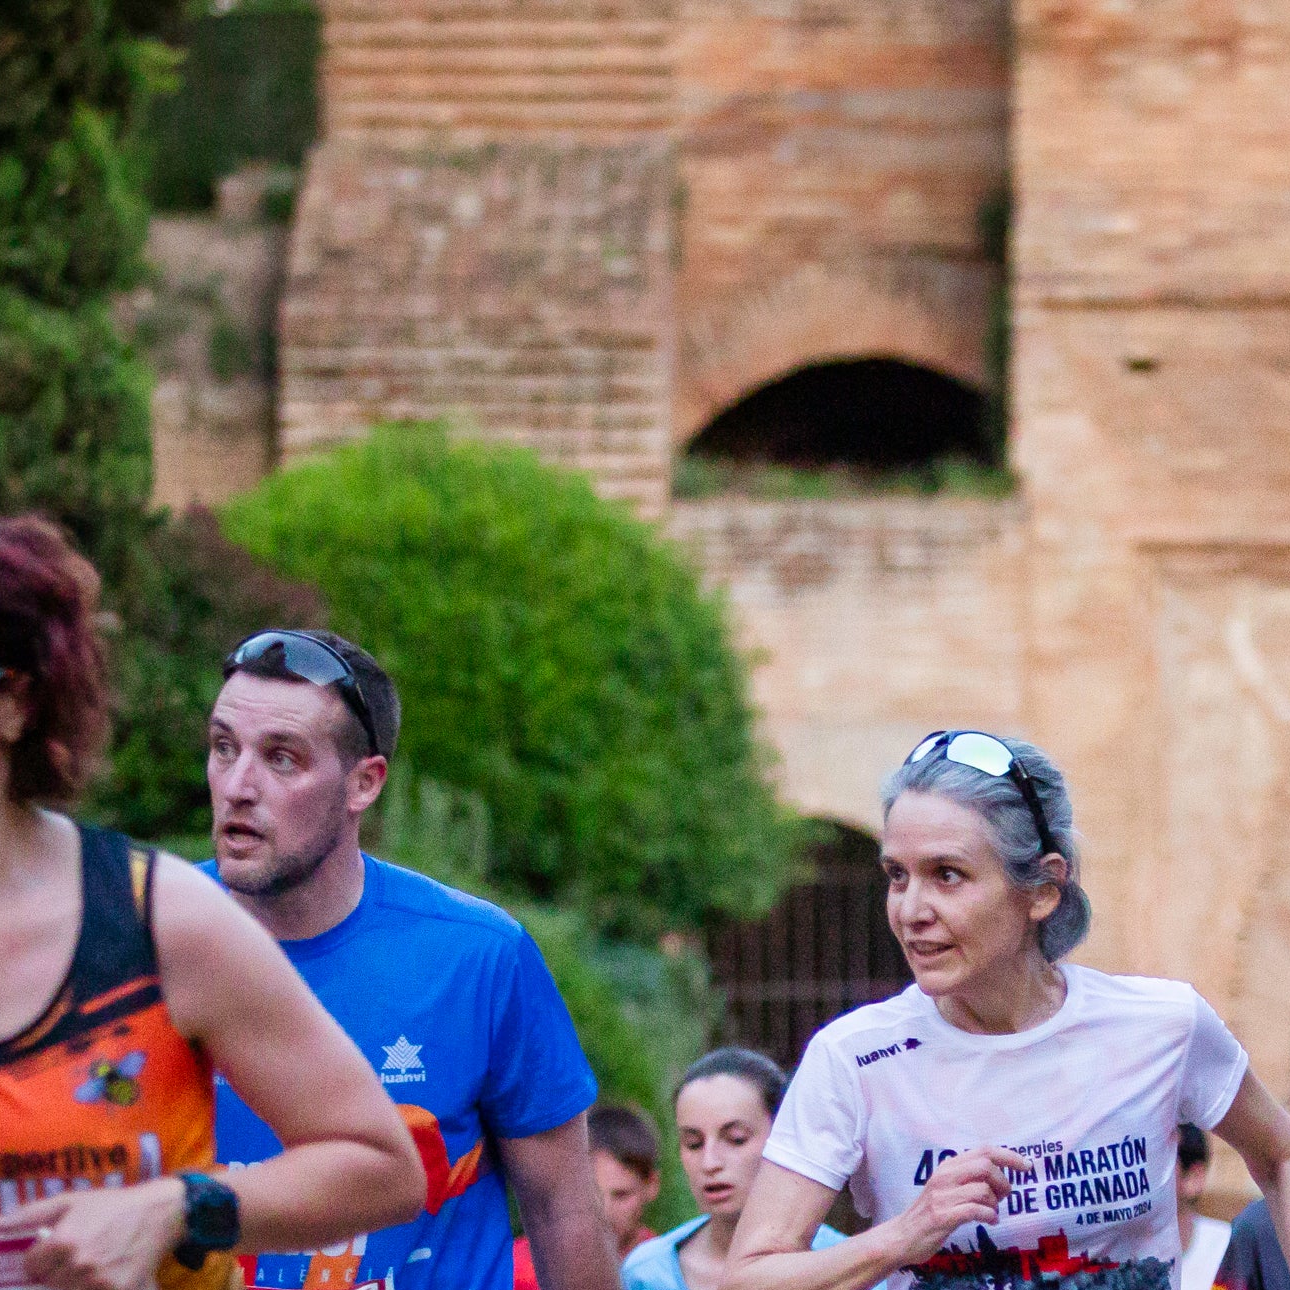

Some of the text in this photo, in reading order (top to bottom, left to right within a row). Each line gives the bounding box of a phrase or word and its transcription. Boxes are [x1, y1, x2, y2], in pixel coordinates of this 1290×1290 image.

[855, 1043, 902, 1067] luanvi
[381, 1068, 426, 1084] luanvi
[1044, 1136, 1148, 1181] MARATÓN
[1007, 1168, 1151, 1216] DE GRANADA
[1076, 1201, 1152, 1225] 4 DE MAYO 2024
